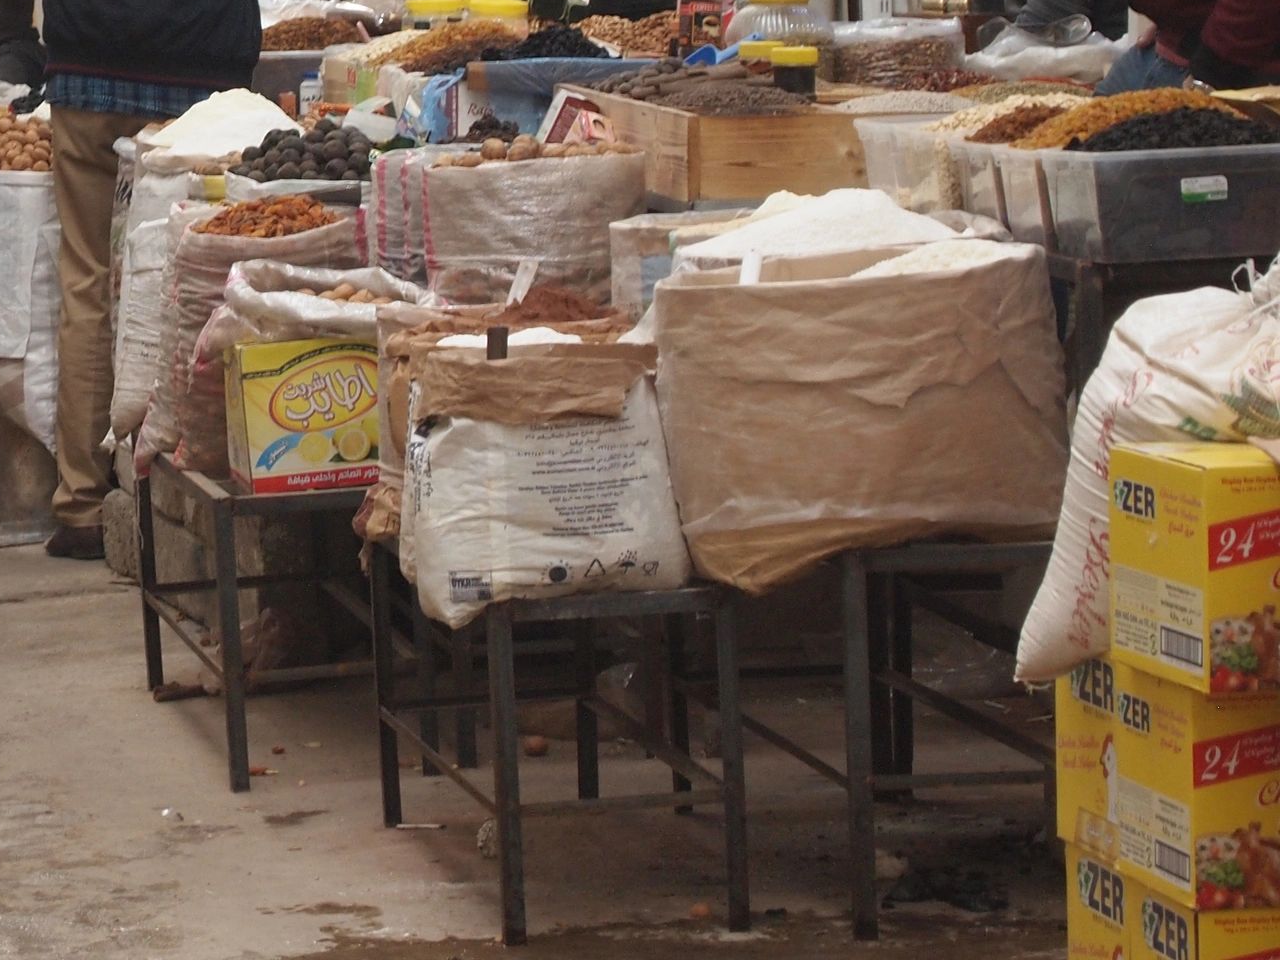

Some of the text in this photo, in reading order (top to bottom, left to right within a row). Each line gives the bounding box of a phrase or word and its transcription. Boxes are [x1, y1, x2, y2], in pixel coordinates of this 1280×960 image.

[284, 370, 327, 402] شربت
[286, 364, 376, 428] اطايب
[1122, 480, 1156, 520] ZER
[1215, 520, 1257, 565] 24
[1122, 693, 1151, 733] ZER
[1200, 739, 1243, 782] 24
[1086, 860, 1124, 926] ZER
[1150, 901, 1189, 960] ZER
